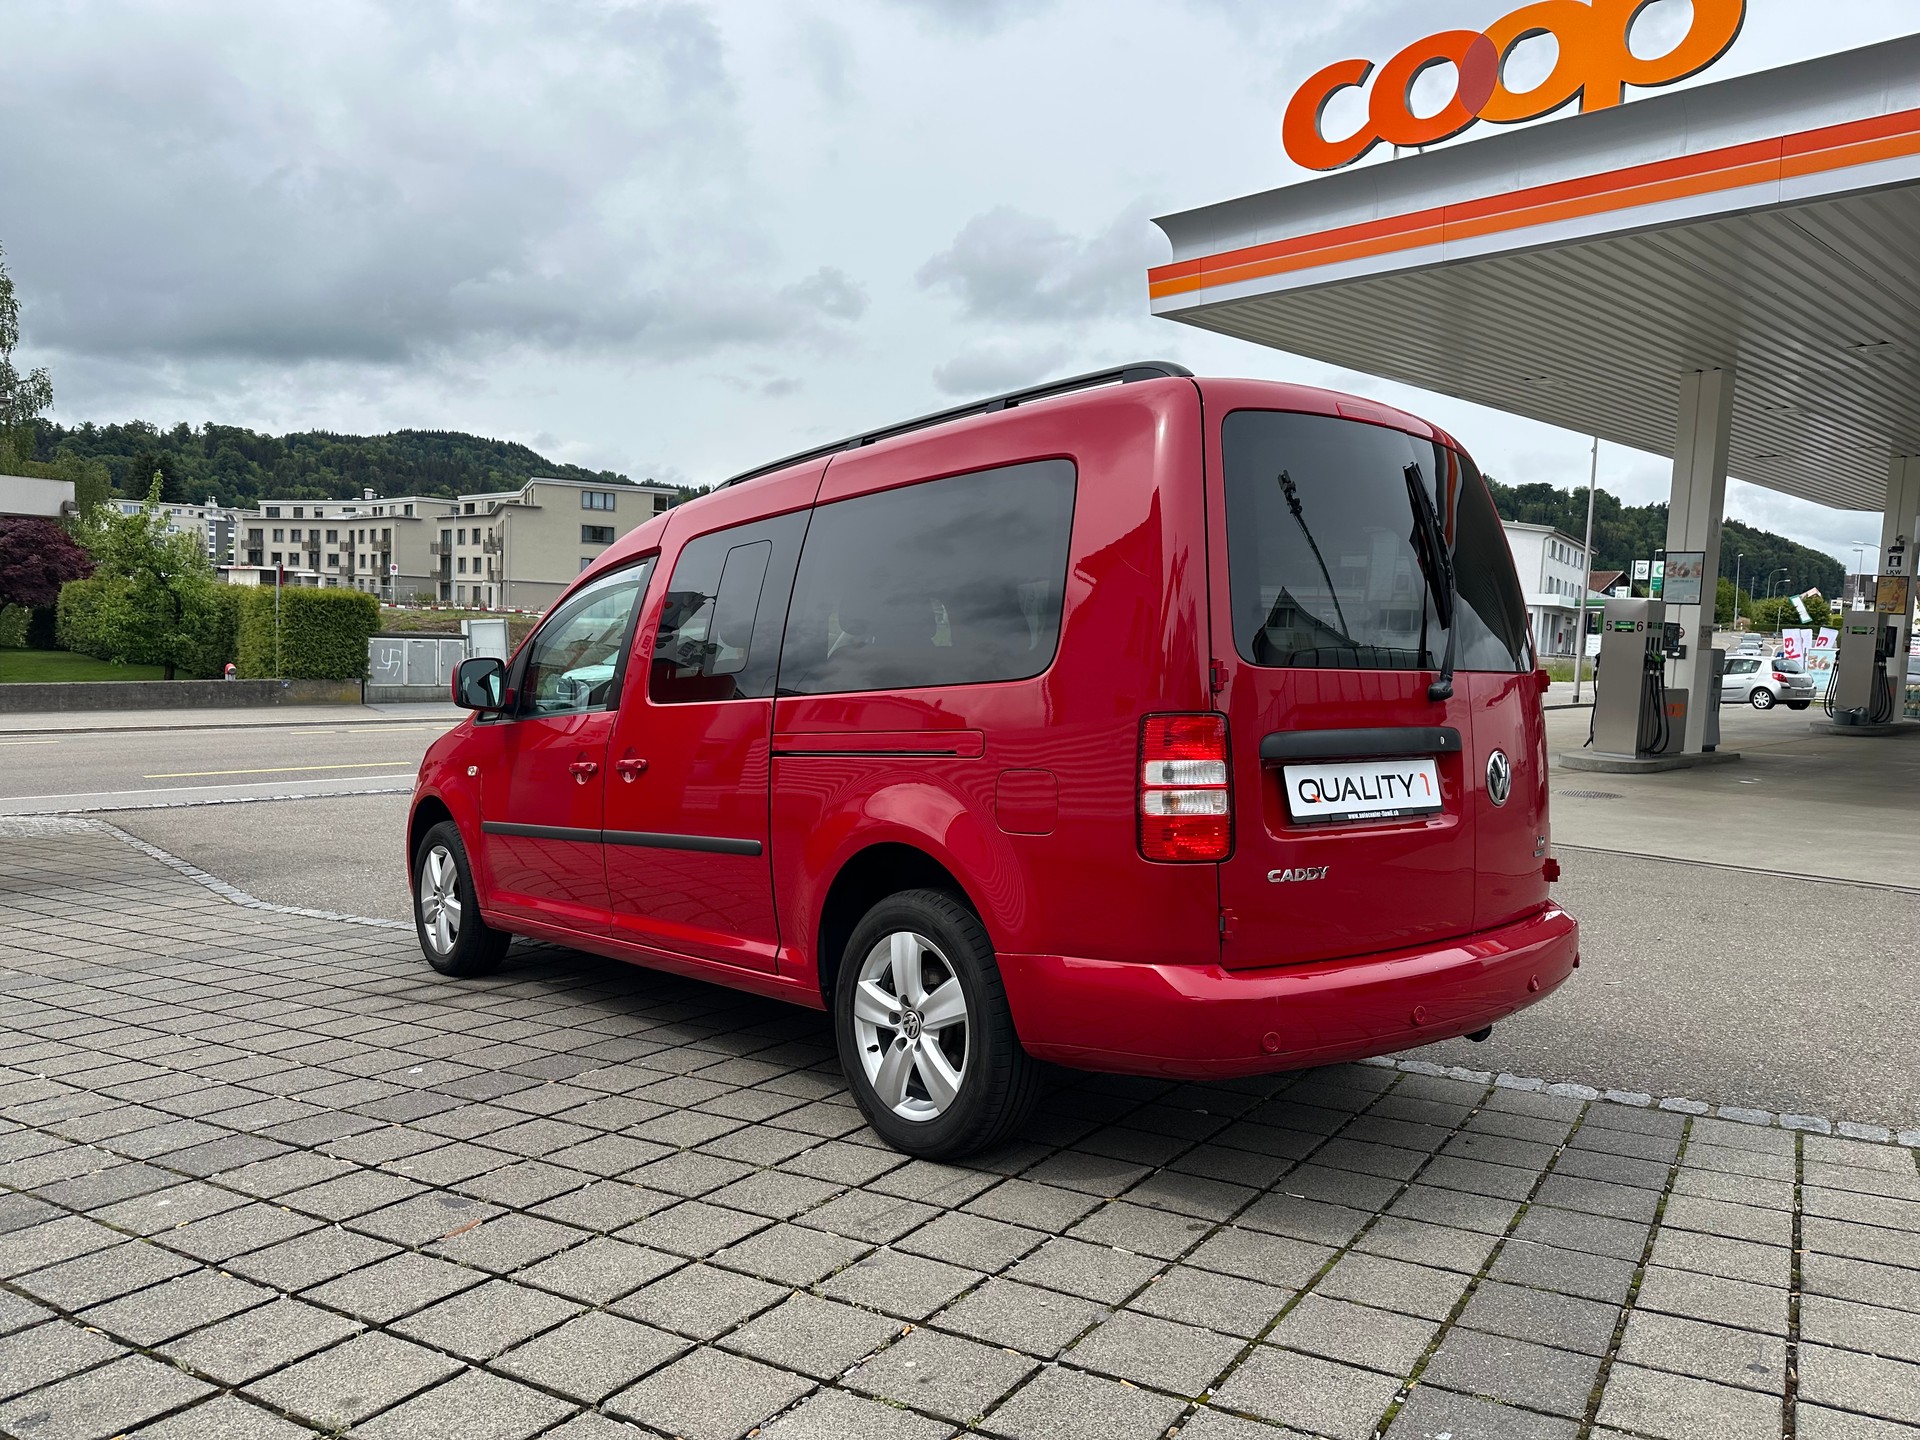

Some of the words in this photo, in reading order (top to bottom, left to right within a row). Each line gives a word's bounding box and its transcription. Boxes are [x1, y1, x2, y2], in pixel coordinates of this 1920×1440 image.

[1281, 0, 1747, 171] coop
[1605, 620, 1613, 632] 5
[1636, 620, 1644, 632] 6
[1868, 626, 1876, 635] 2
[1298, 773, 1414, 804] QUALITY
[1267, 865, 1330, 883] CADDY
